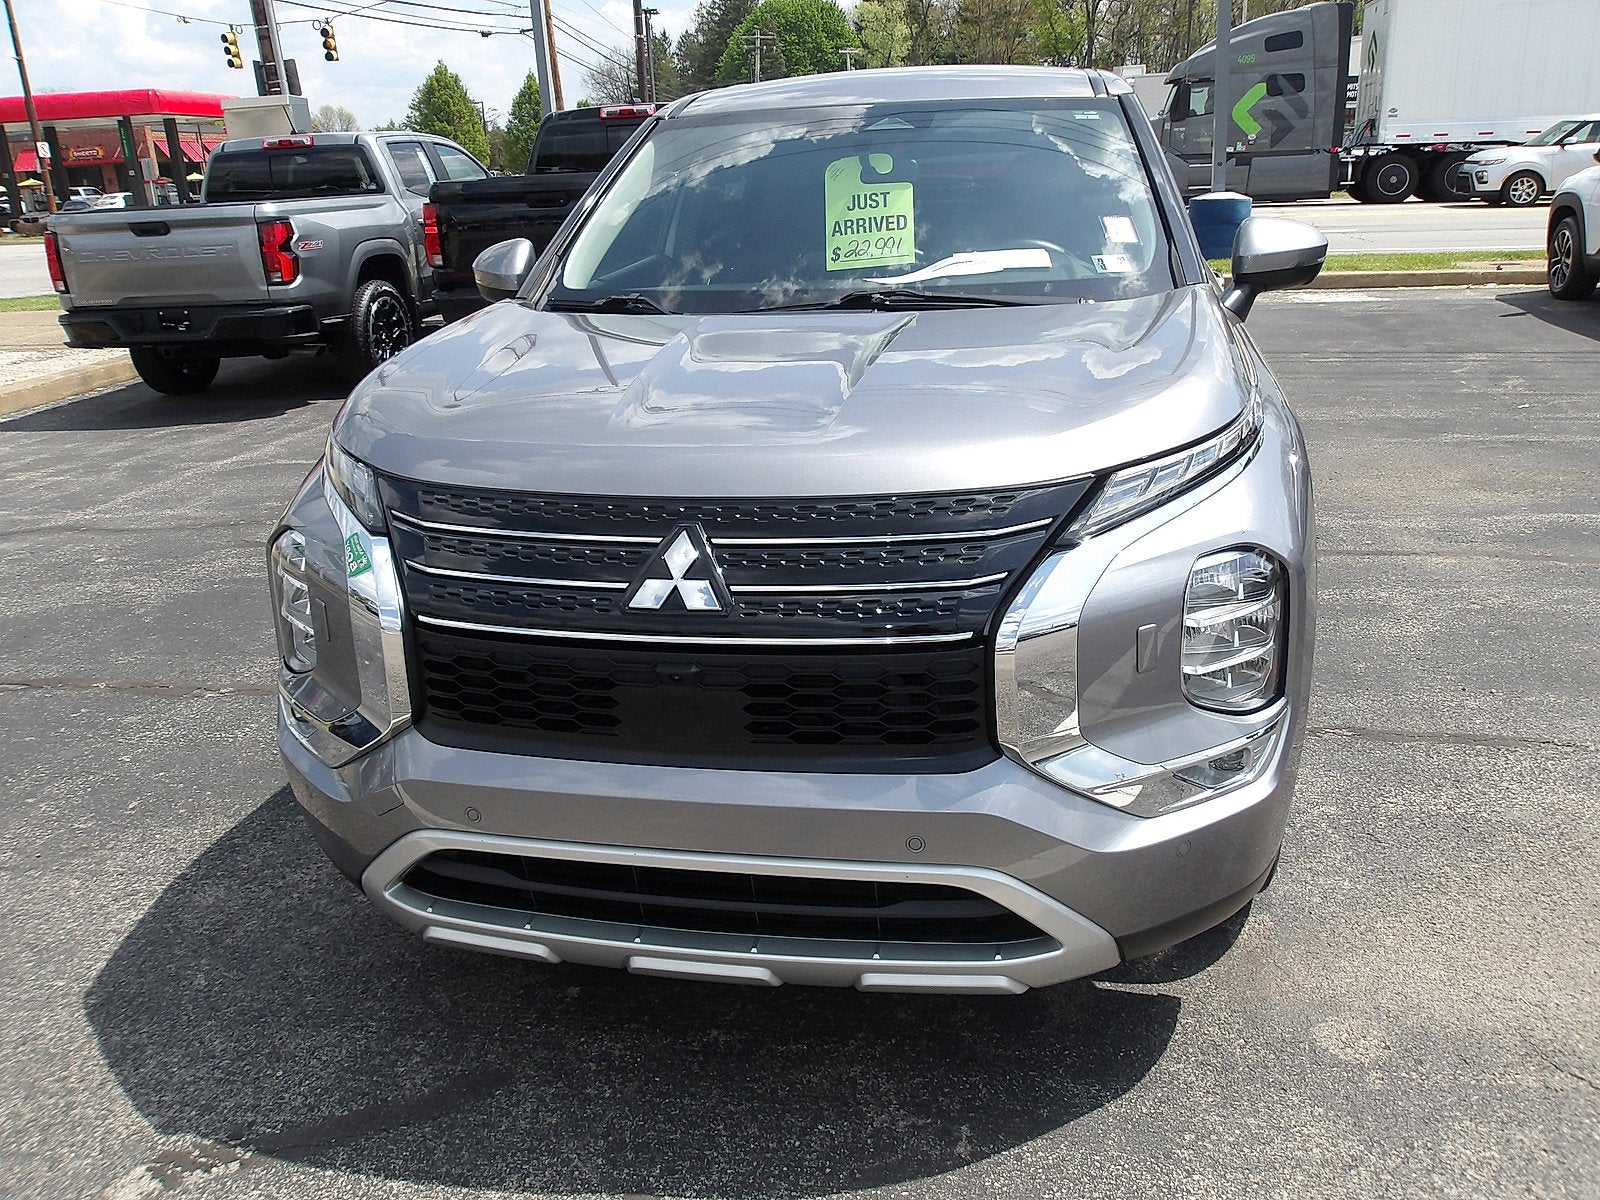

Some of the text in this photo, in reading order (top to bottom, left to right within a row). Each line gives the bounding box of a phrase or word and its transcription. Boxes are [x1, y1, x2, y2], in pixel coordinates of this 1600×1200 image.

[846, 191, 890, 212] JUST
[831, 214, 908, 237] ARRIVED
[78, 244, 234, 263] CHEVROLET
